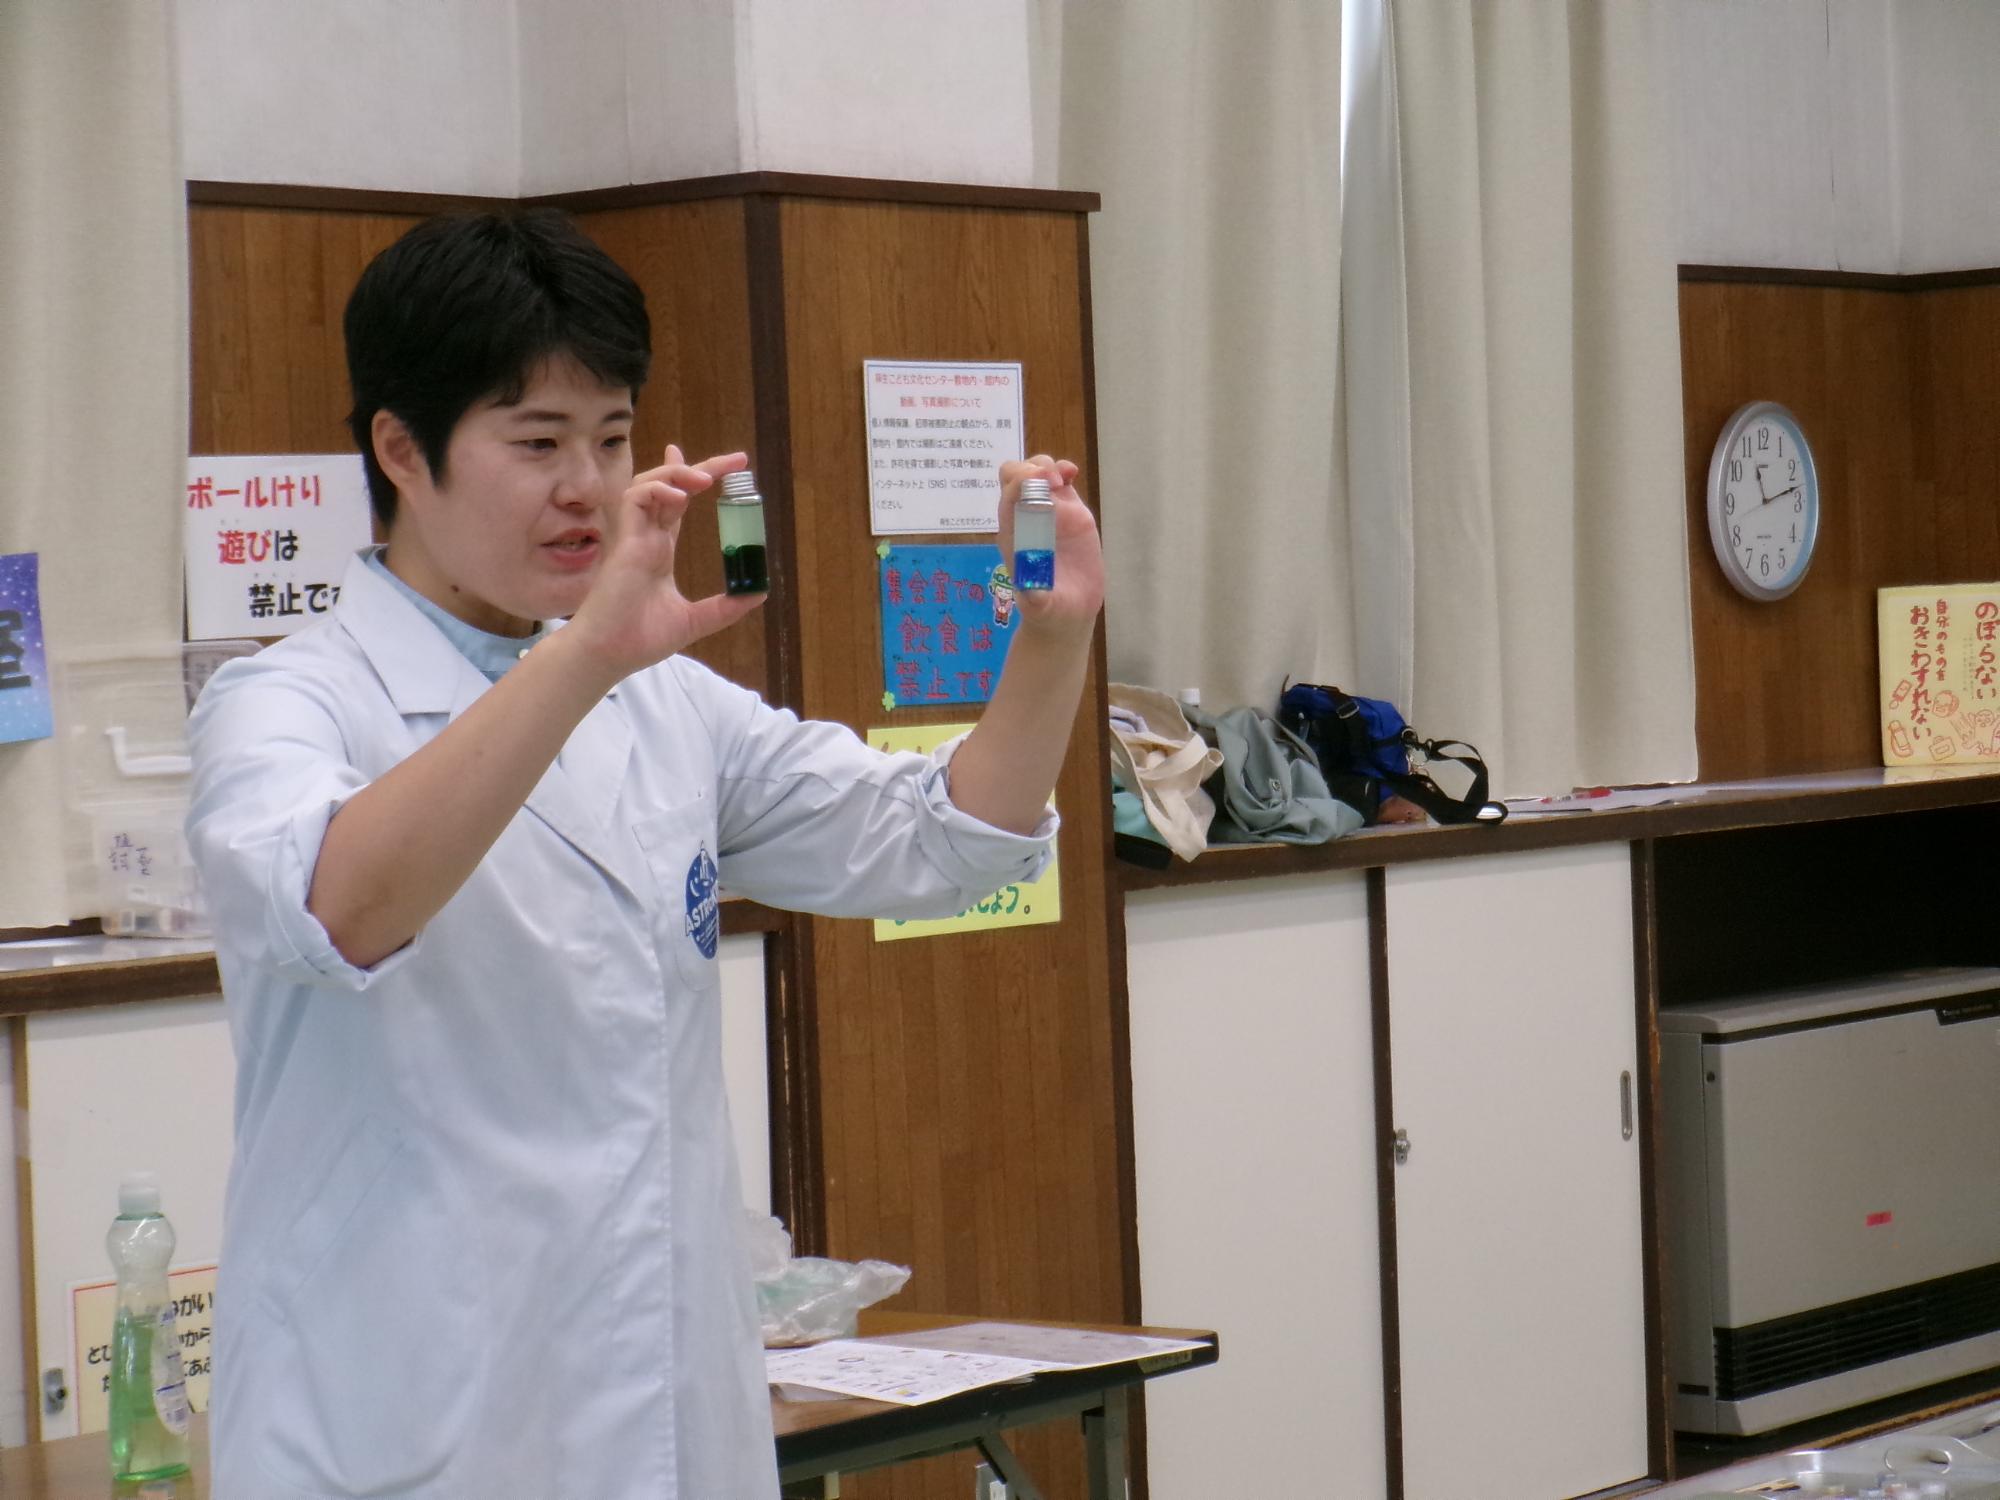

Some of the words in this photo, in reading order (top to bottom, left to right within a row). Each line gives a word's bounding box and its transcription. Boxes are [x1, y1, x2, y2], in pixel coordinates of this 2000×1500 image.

[1742, 436, 1752, 458] 11
[1758, 428, 1769, 450] 12
[1778, 436, 1783, 458] 1
[1731, 460, 1743, 482] 10
[1788, 459, 1796, 481] 2
[187, 475, 320, 509] ボールけり
[1794, 491, 1802, 513] 3
[1727, 493, 1735, 515] 9
[1733, 525, 1742, 547] 8
[1789, 522, 1796, 543] 4
[218, 529, 298, 564] 遊びは
[1746, 548, 1753, 569] 7
[1760, 554, 1770, 576] 6
[1778, 548, 1785, 569] 5
